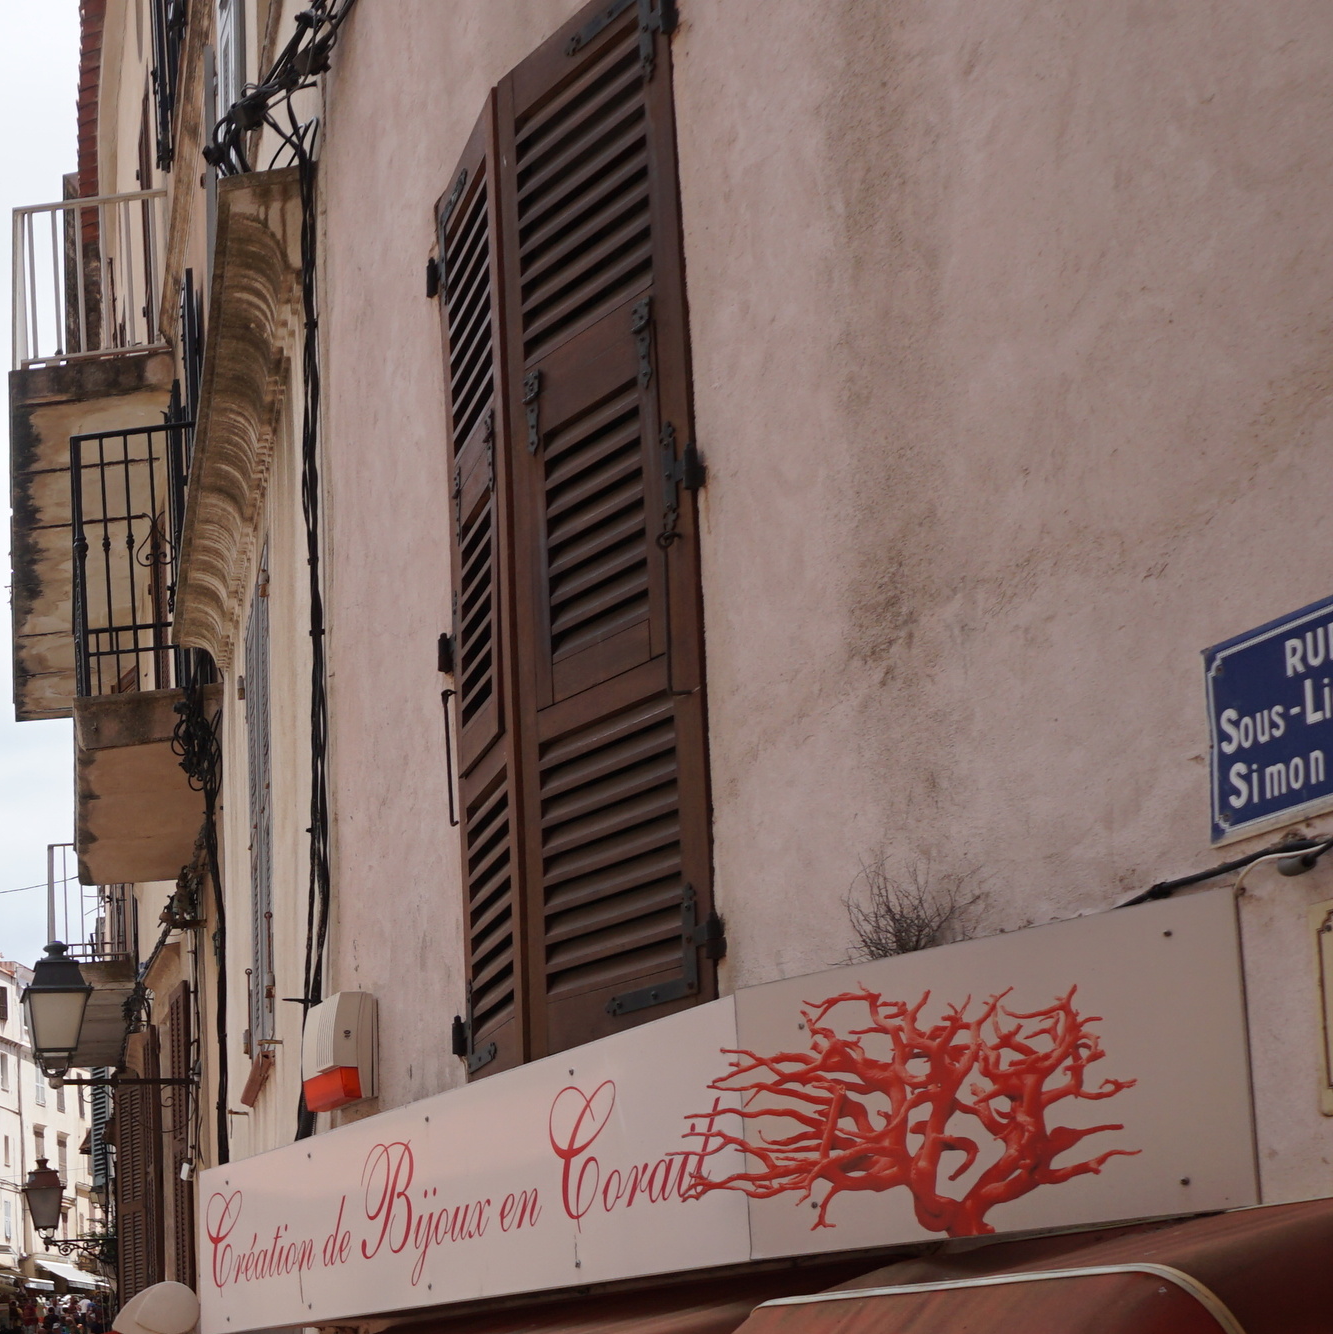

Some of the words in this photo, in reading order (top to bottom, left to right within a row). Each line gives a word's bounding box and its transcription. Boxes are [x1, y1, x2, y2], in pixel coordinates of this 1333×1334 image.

[1220, 677, 1333, 755] Sous-Li
[1228, 749, 1325, 809] Simon
[206, 1190, 316, 1298] Création
[322, 1194, 352, 1267] de
[361, 1139, 491, 1287] Bijoux
[499, 1187, 542, 1233] en
